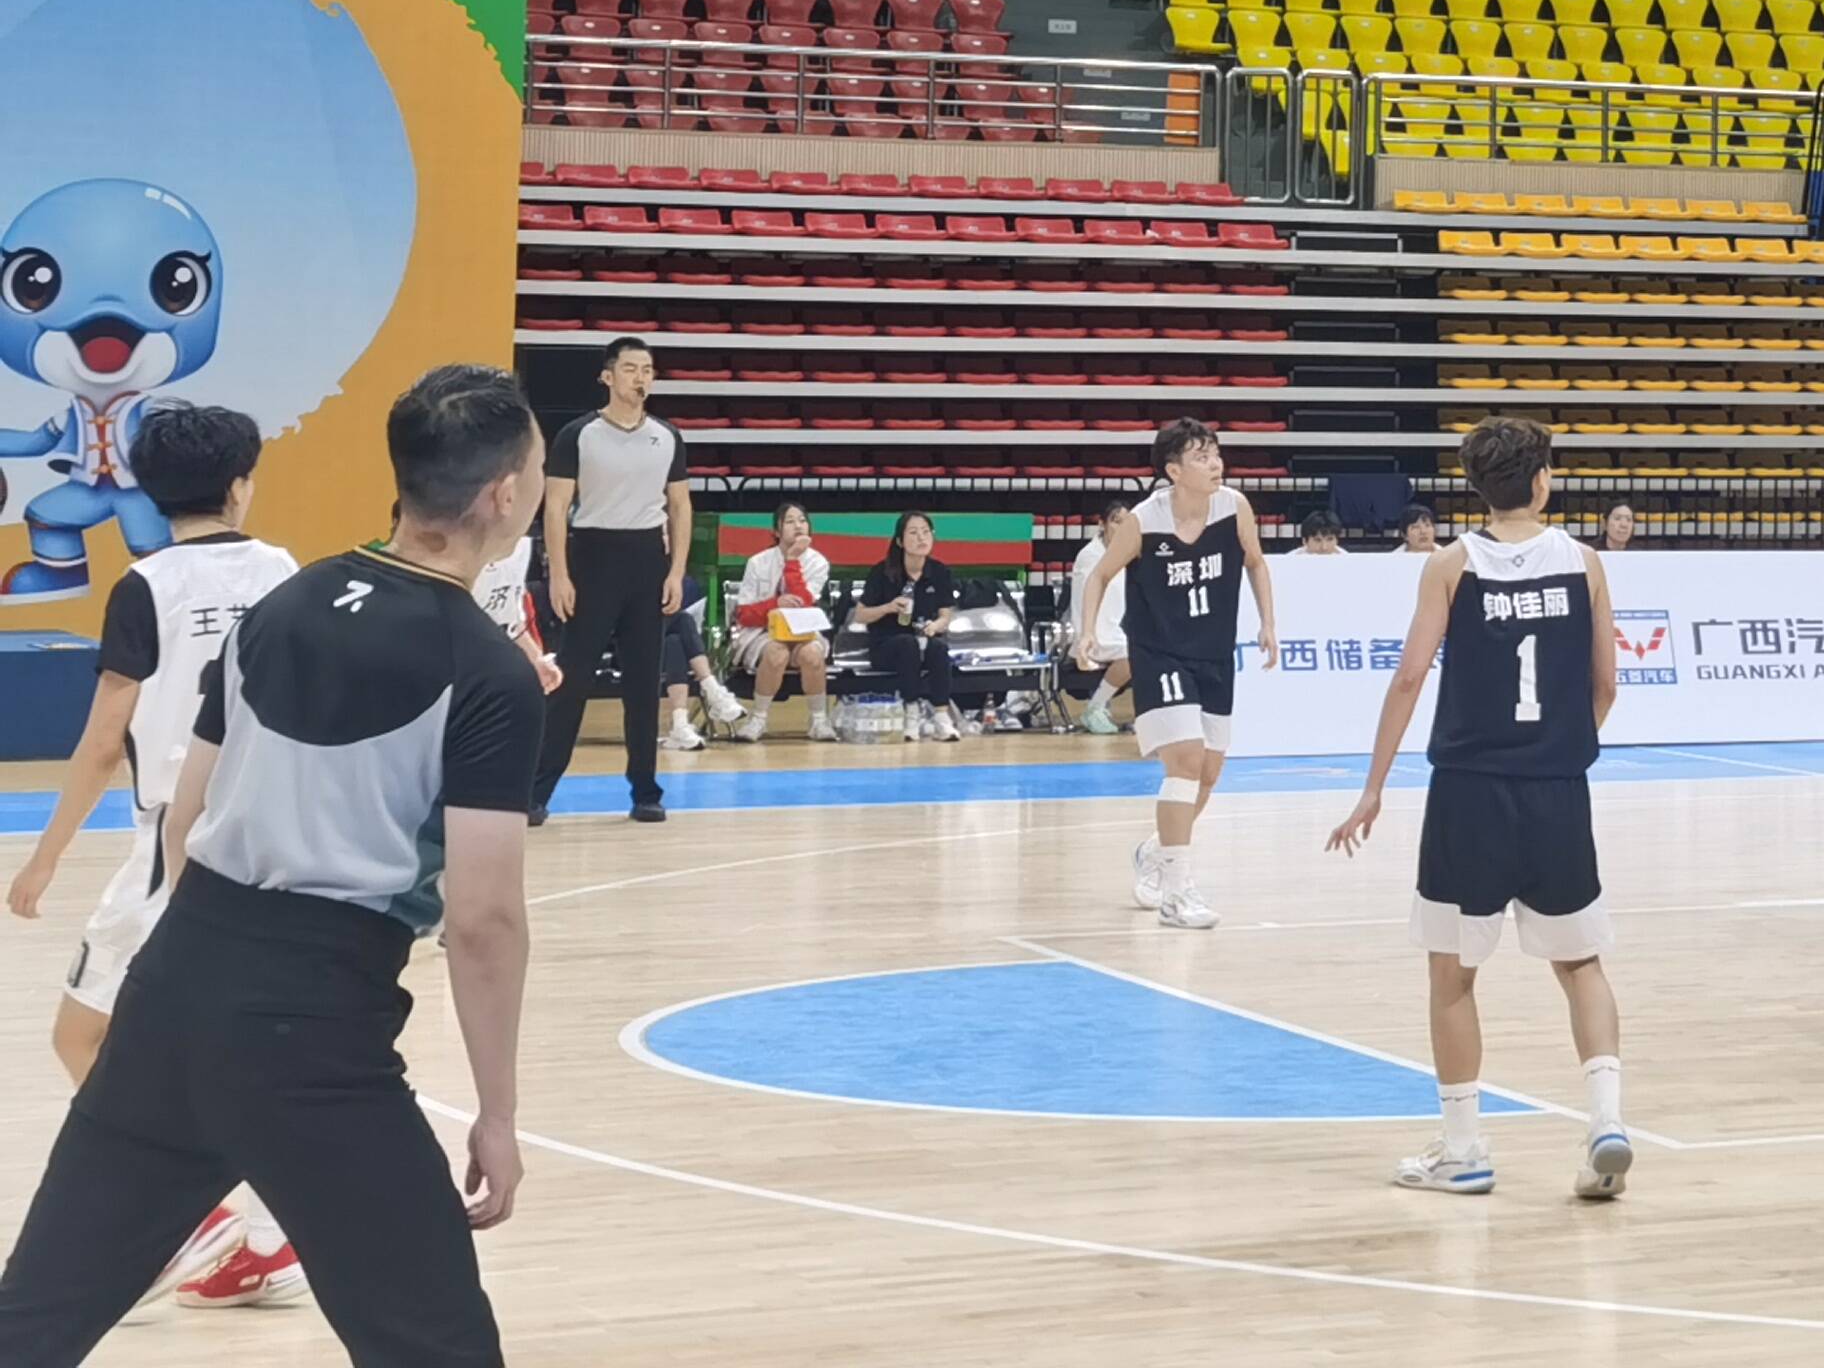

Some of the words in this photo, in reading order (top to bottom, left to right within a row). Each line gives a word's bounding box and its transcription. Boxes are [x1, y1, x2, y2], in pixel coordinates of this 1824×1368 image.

[1167, 553, 1222, 587] 深圳
[1188, 586, 1210, 617] 11
[1484, 587, 1569, 621] 钟佳丽
[1236, 638, 1446, 672] 广西储备
[1697, 663, 1806, 681] GUANGXI
[1160, 672, 1184, 702] 11
[1514, 634, 1541, 722] 1
